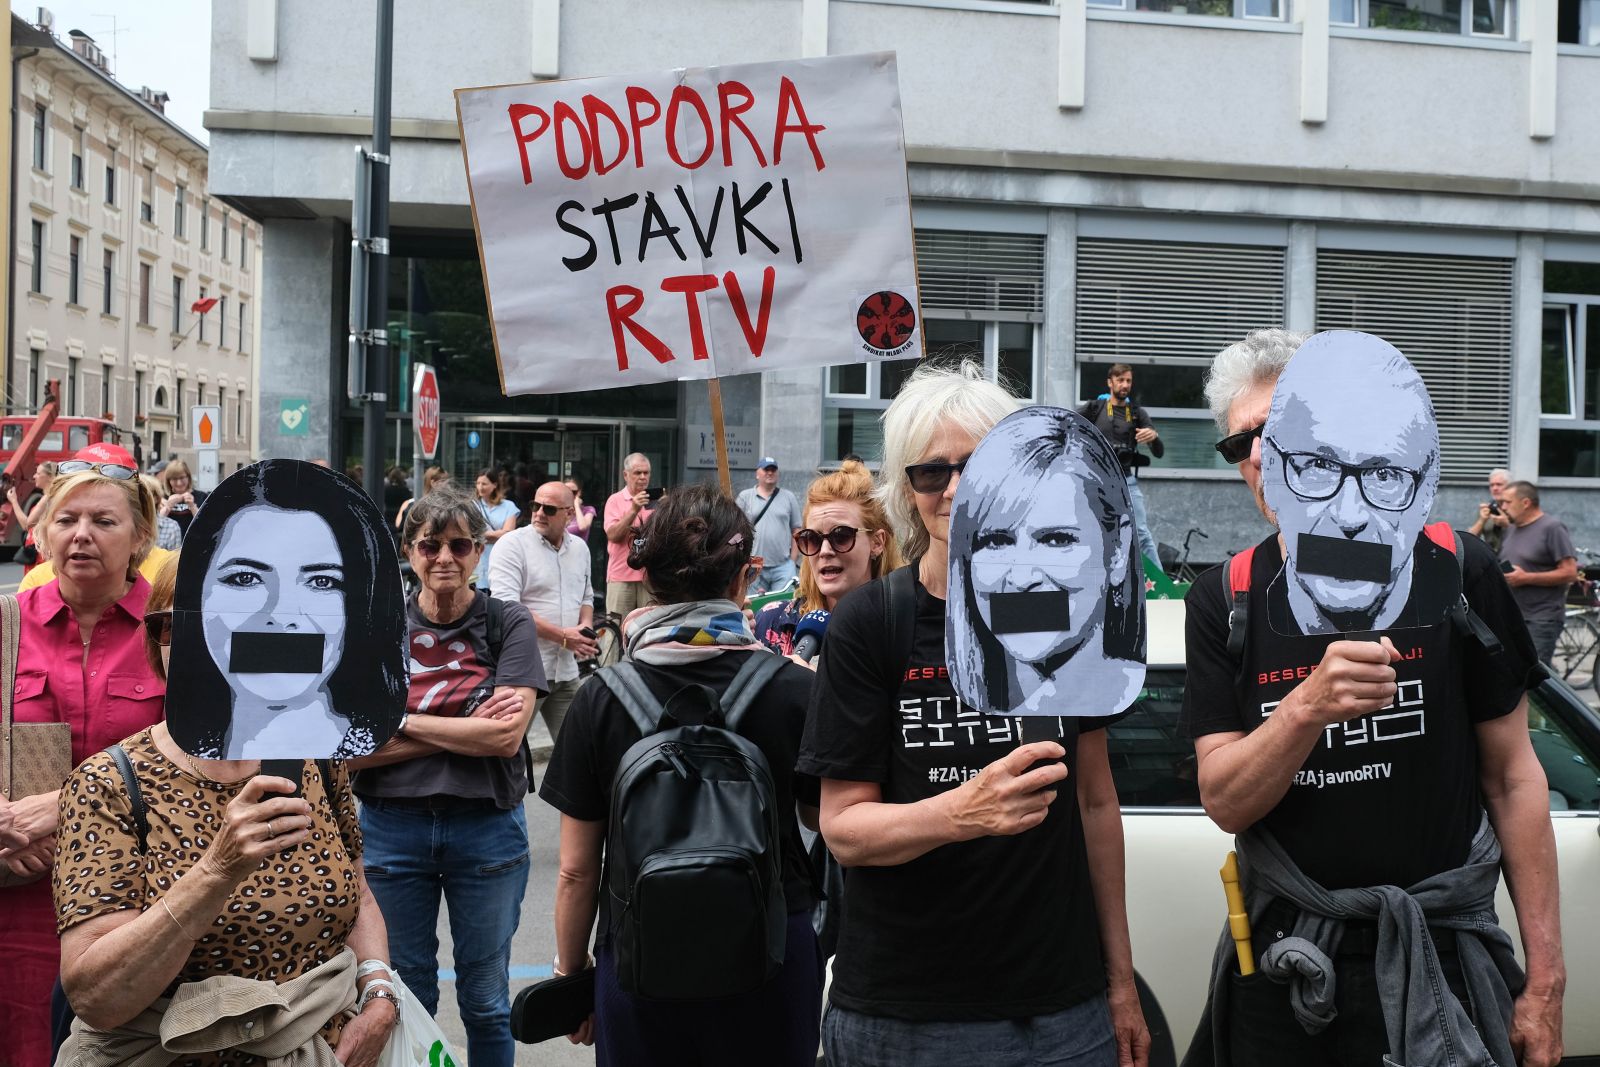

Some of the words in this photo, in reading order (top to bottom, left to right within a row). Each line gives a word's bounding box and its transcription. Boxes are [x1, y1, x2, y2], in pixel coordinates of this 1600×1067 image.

[508, 77, 825, 185] PODPORA
[556, 178, 803, 272] STAVKI
[606, 266, 776, 371] RTV
[902, 340, 914, 352] PLUS
[419, 397, 438, 429] STOP
[806, 613, 825, 623] SLO
[902, 718, 1012, 748] CITY
